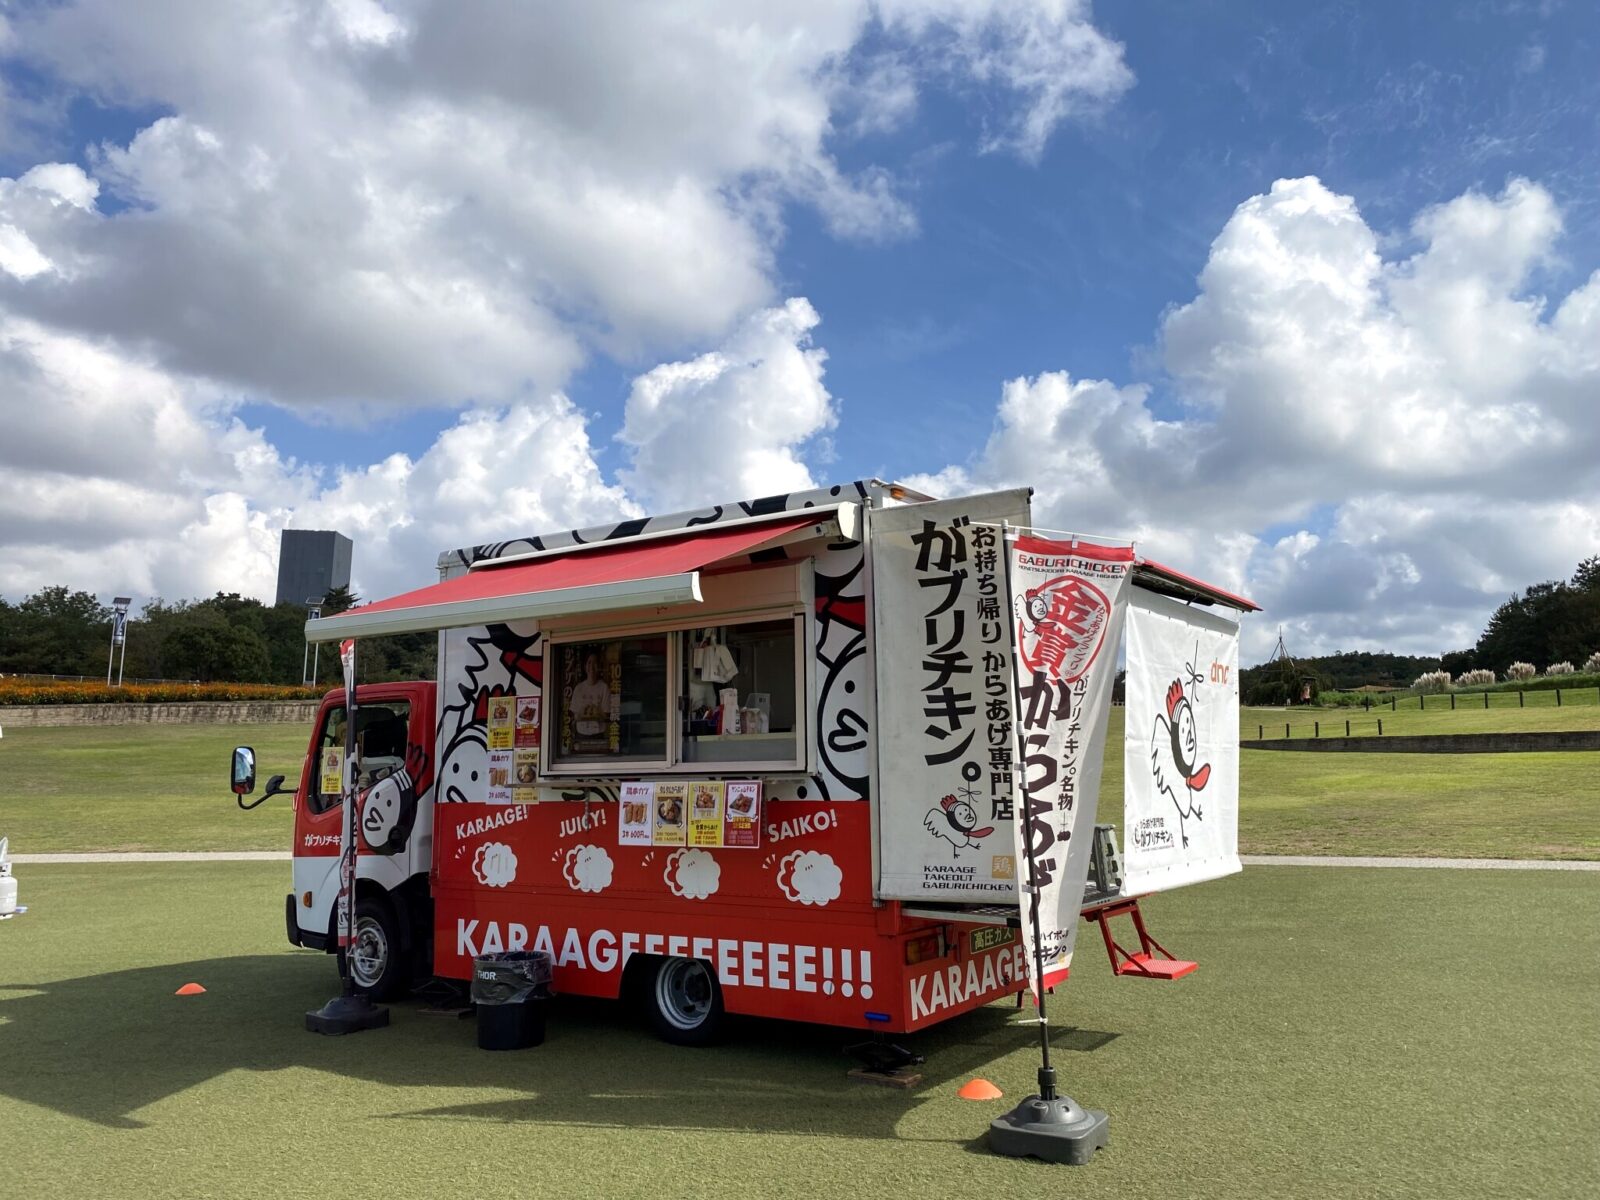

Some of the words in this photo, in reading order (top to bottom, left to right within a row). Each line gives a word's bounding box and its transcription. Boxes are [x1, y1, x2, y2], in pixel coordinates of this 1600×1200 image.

[1019, 554, 1127, 574] GABURICHICKEN
[911, 515, 982, 782] がブリチキン。
[456, 805, 528, 839] KARAAGE!
[559, 809, 606, 838] JUICY!
[768, 809, 837, 843] SAIKO!
[924, 865, 976, 874] KARAAGE
[924, 874, 974, 882] TAKEOUT
[923, 882, 1013, 891] GABURICHICKEN
[974, 927, 1012, 950] 高圧ガス
